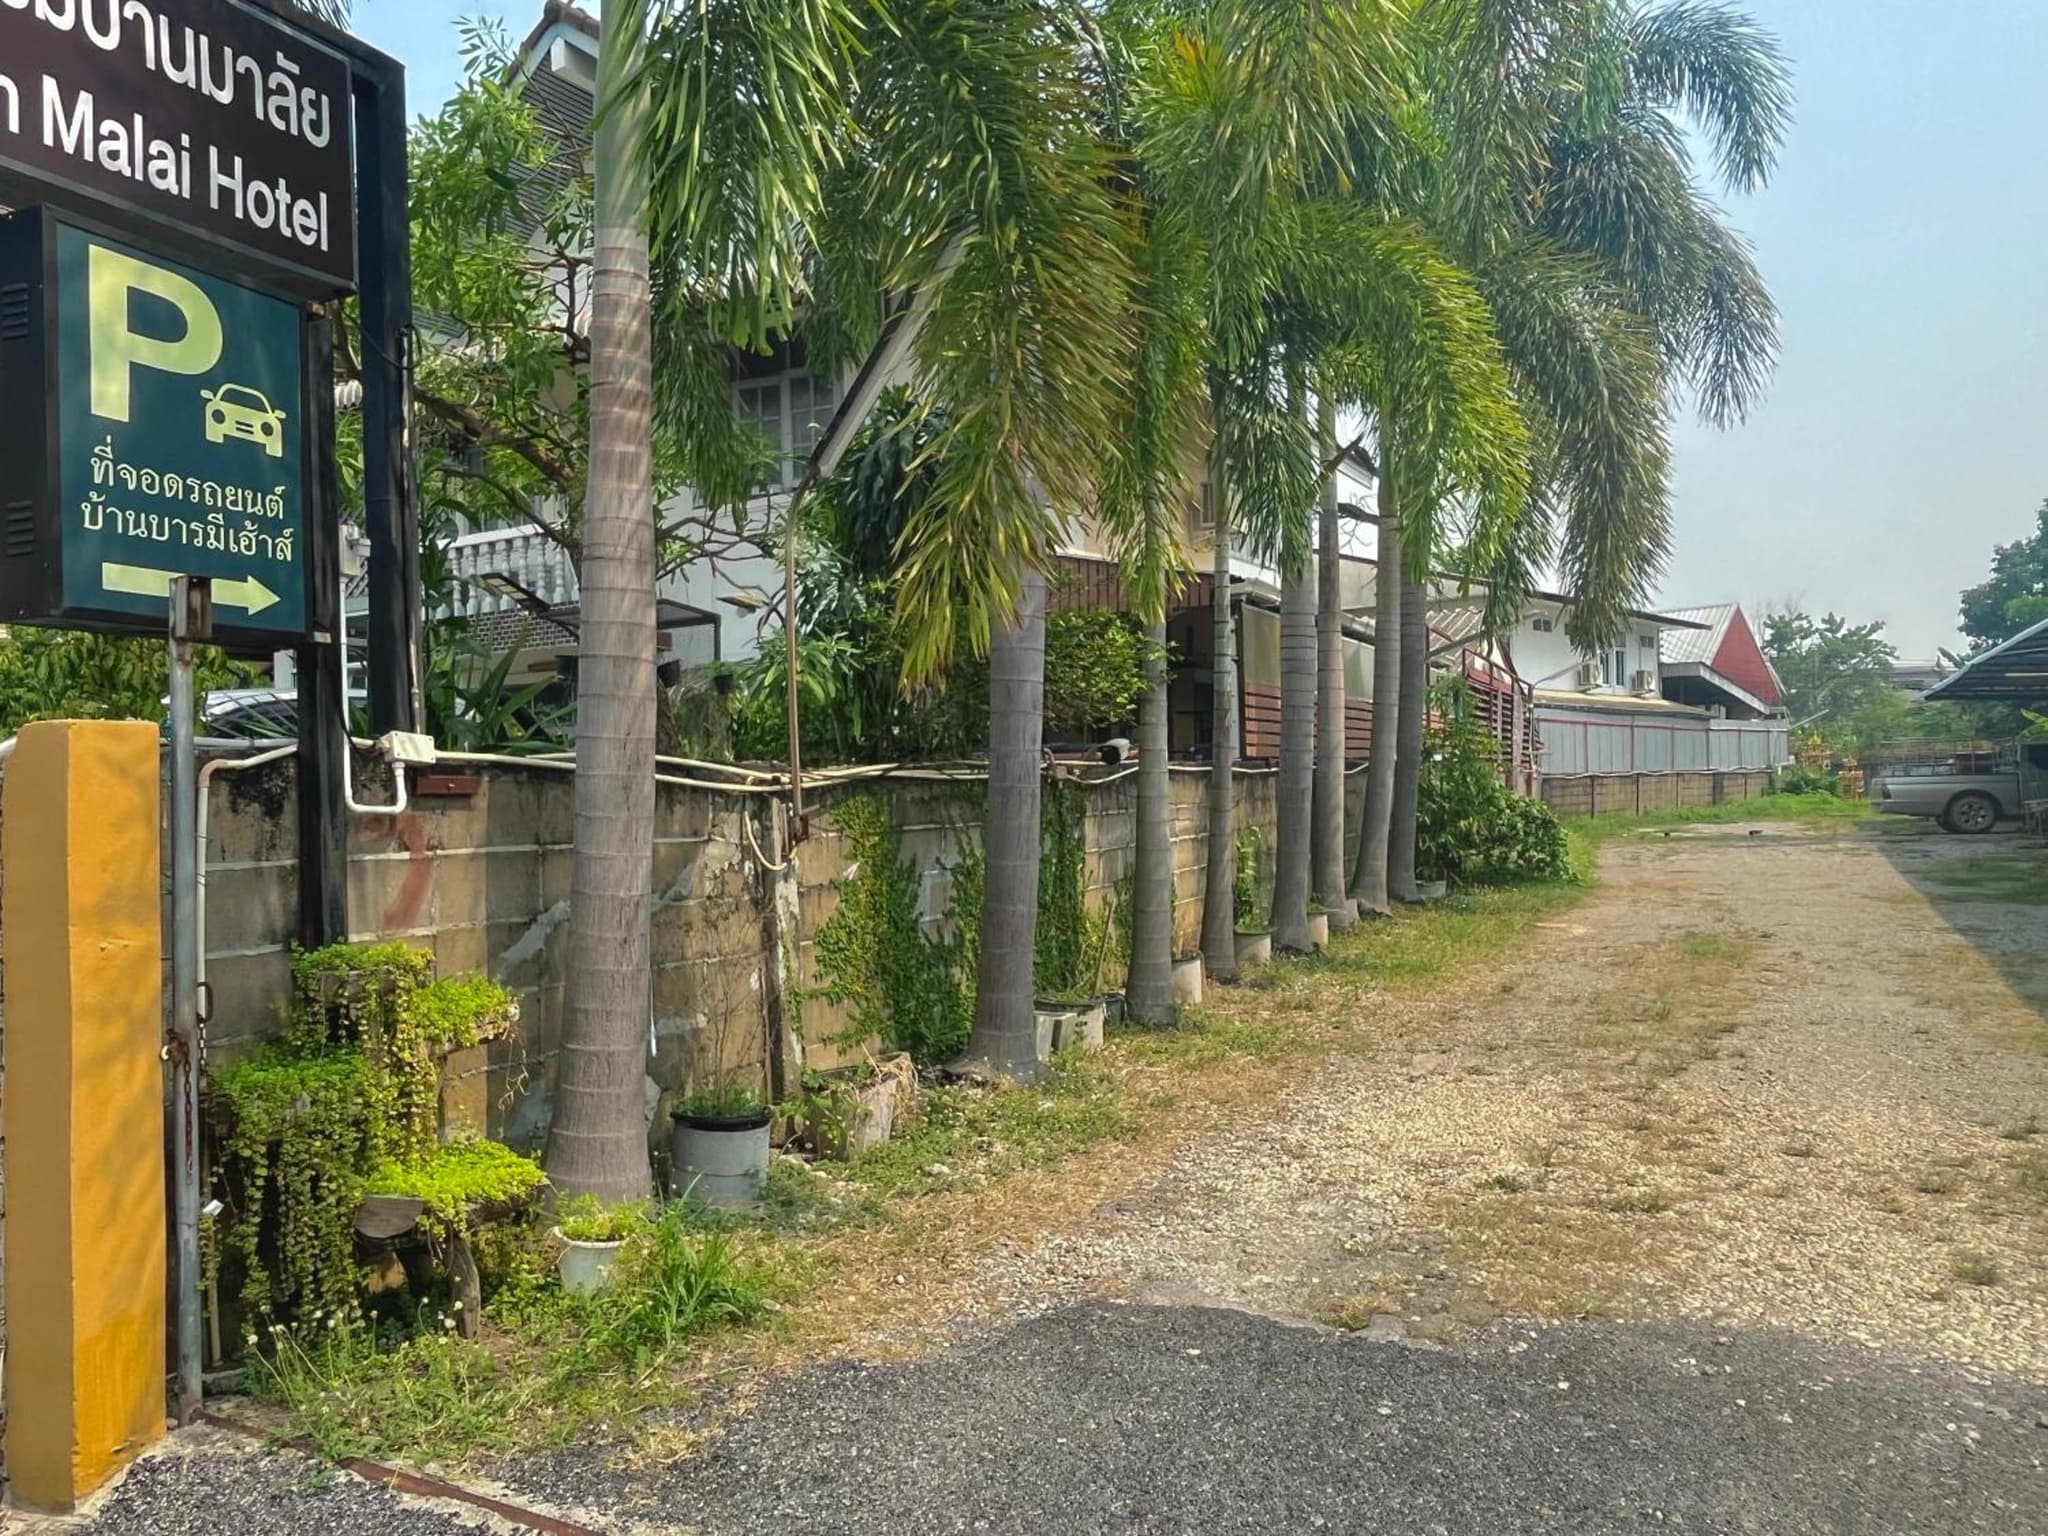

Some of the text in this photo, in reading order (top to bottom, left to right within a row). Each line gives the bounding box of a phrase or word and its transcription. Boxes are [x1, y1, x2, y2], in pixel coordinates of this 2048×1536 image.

[42, 74, 190, 199] Malai
[209, 145, 329, 252] Hotel
[89, 244, 223, 422] P
[80, 490, 295, 562] บ้านบารมีเฮ้าส์
[90, 434, 286, 520] ที่จอดรถยนต์
